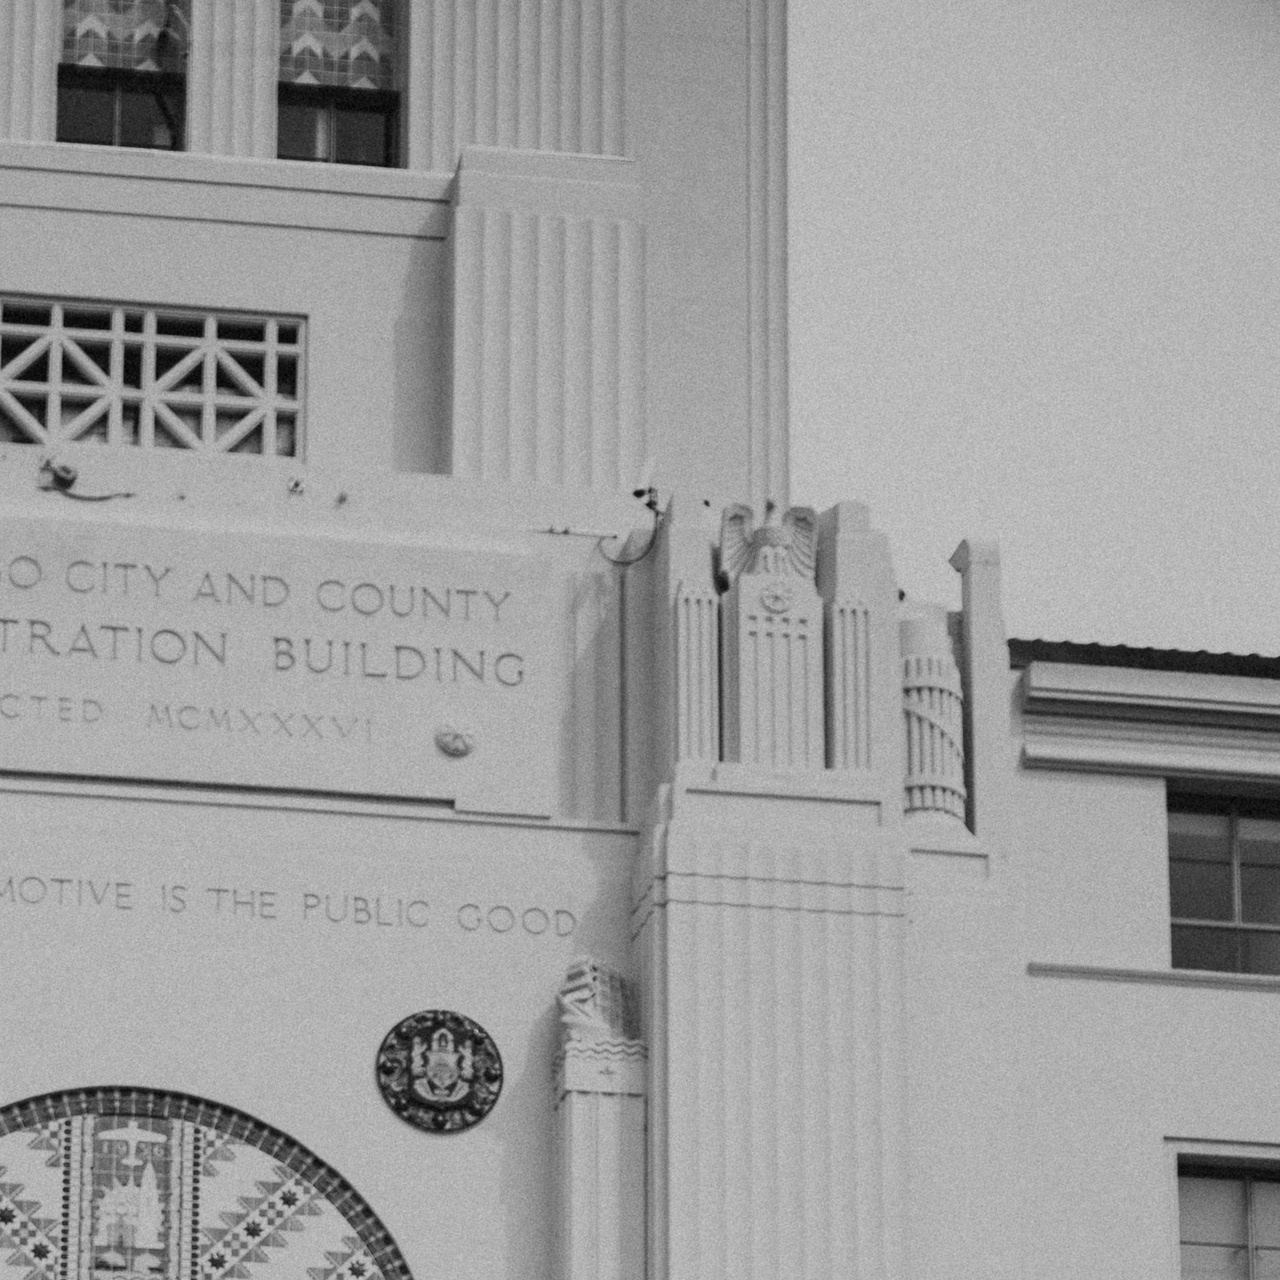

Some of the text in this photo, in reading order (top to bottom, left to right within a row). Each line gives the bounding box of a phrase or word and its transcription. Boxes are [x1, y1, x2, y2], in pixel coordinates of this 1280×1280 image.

[65, 560, 173, 598] CITY
[192, 572, 290, 608] AND
[315, 579, 512, 621] COUNTY
[272, 635, 524, 688] BUILDING
[144, 704, 372, 742] MCMXXXVI
[161, 884, 187, 914] IS
[206, 887, 278, 920] THE
[302, 893, 430, 928] PUBLIC
[457, 903, 578, 938] GOOD
